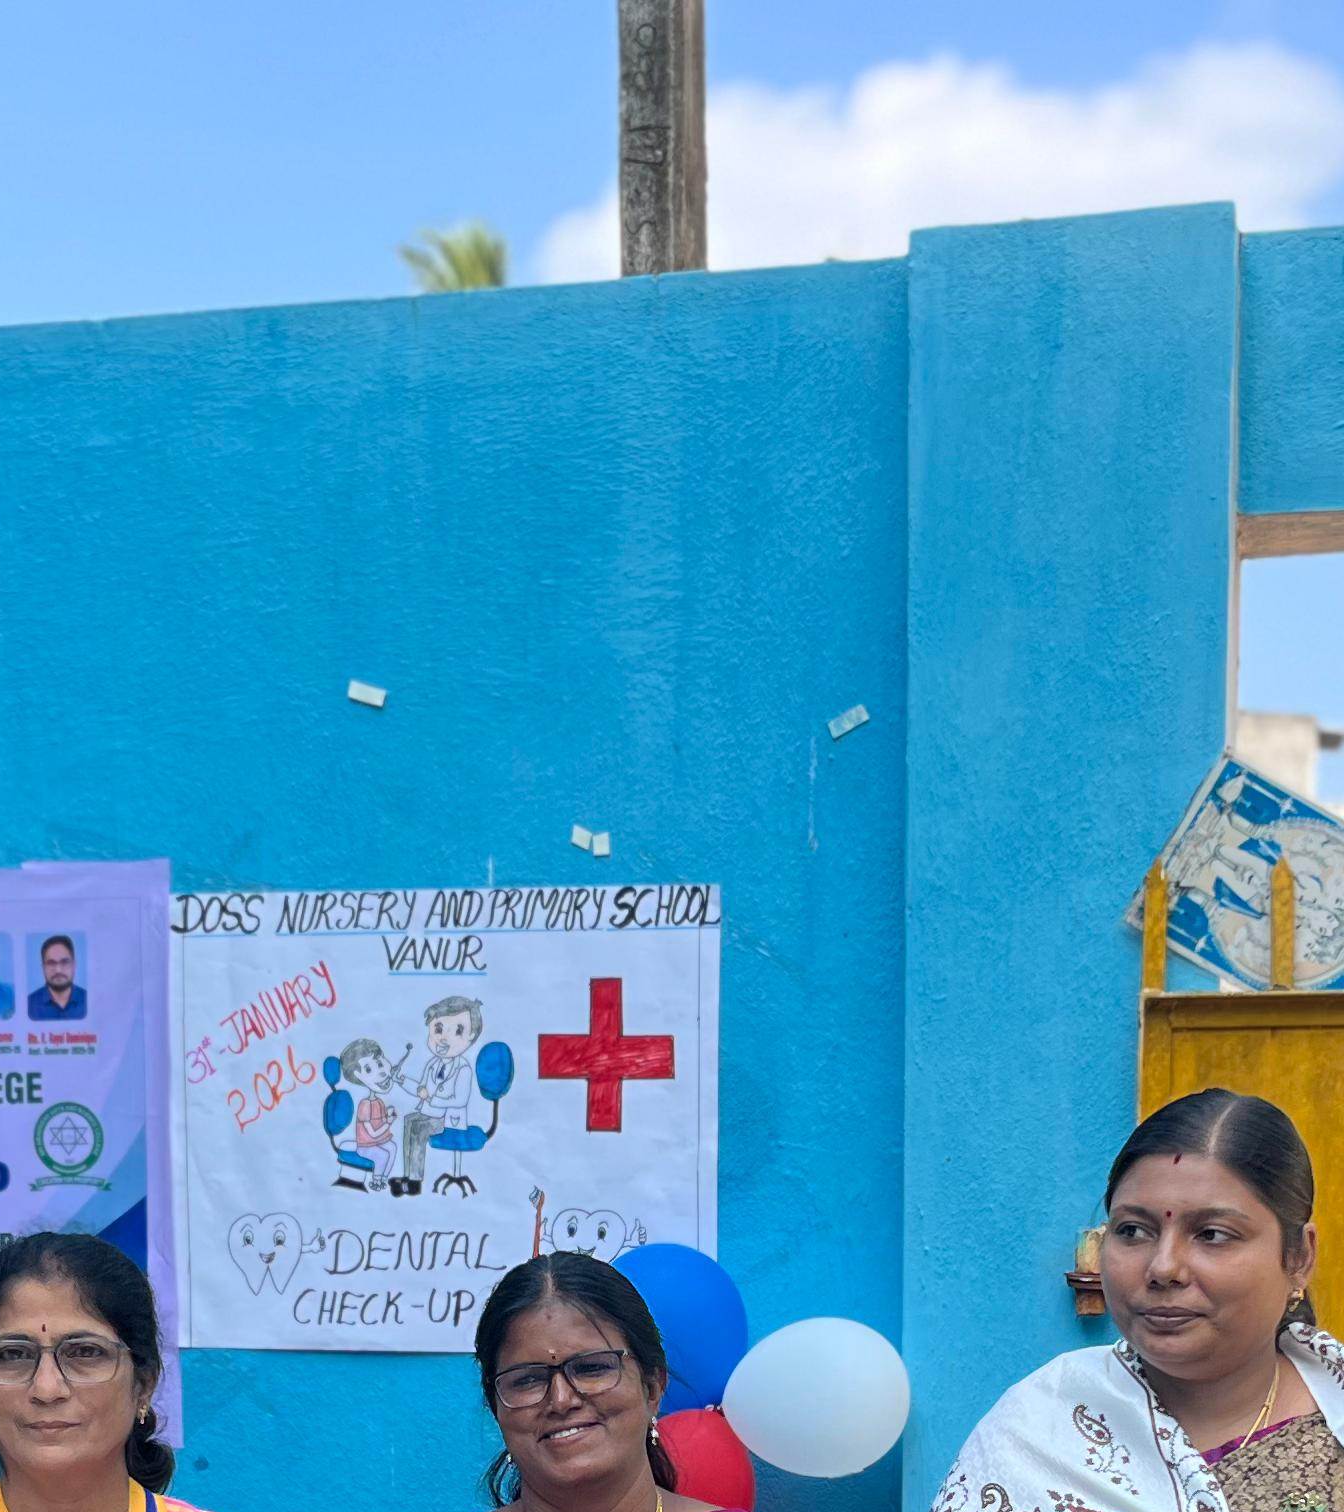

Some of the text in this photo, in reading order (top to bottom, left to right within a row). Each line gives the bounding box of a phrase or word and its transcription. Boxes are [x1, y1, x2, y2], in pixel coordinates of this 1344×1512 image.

[170, 885, 721, 935] DOSS NURSERY AND PRIMARY SCHOOL
[382, 935, 488, 972] VANUR
[227, 1044, 317, 1134] 2026
[324, 1230, 507, 1275] DENTAL
[293, 1289, 476, 1326] CHECK-UP
